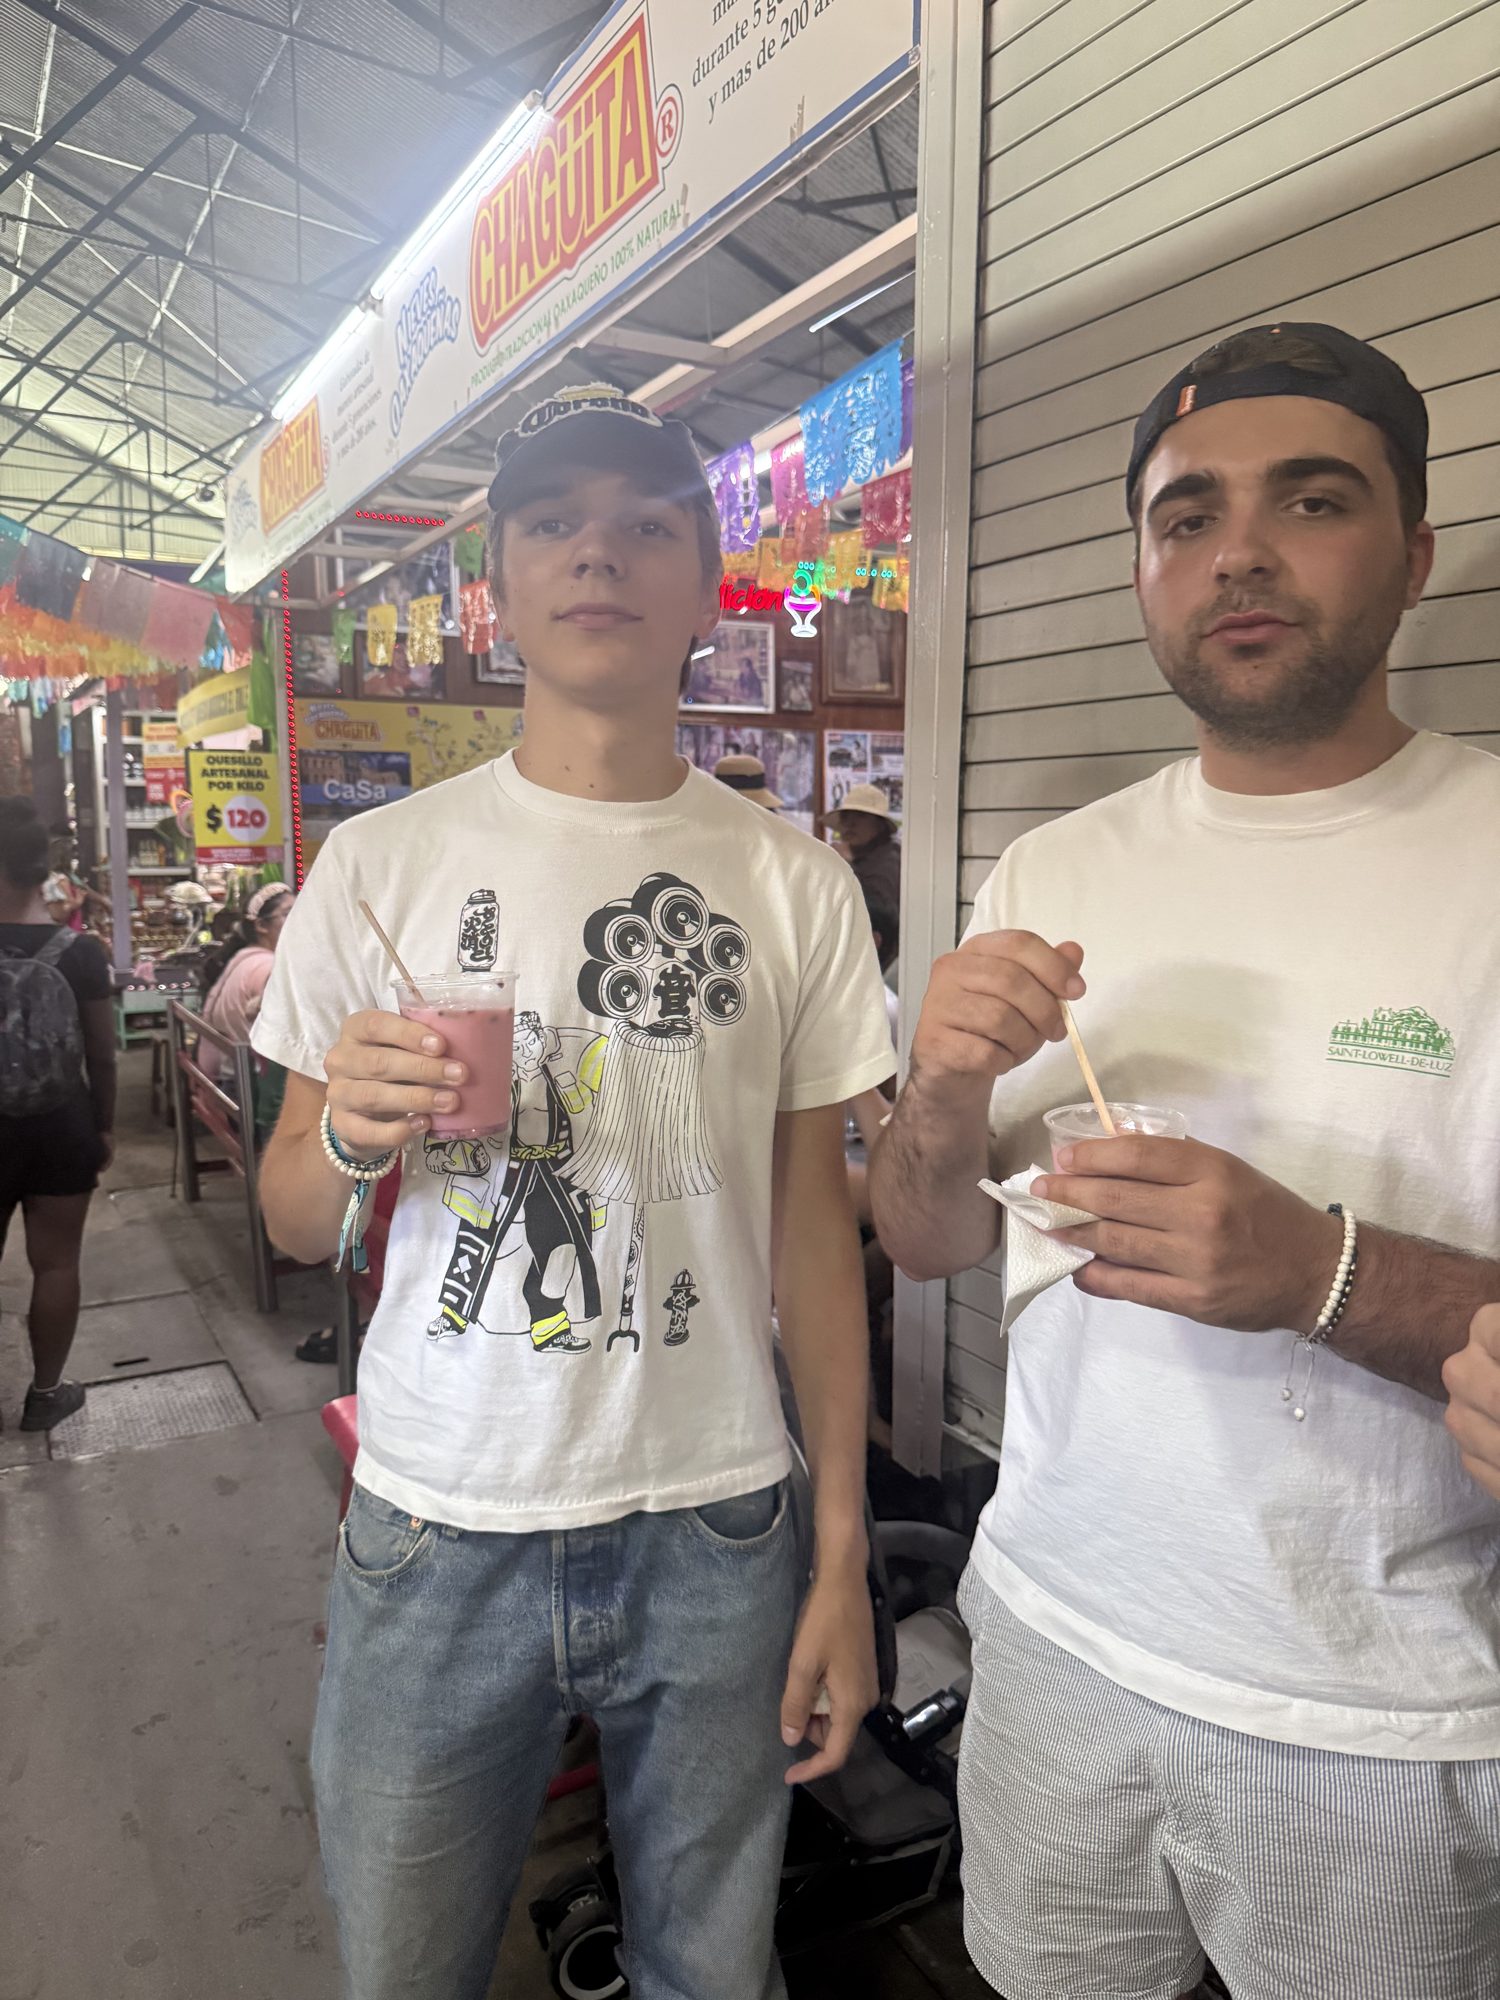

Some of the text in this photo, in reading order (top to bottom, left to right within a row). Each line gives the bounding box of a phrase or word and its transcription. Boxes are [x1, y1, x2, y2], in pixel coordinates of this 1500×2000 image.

[692, 18, 749, 87] durante
[753, 0, 762, 29] 5
[708, 90, 718, 124] y
[721, 67, 752, 104] mas
[757, 36, 776, 70] de
[780, 0, 809, 49] 200
[611, 237, 634, 275] 100%
[636, 199, 682, 252] NATURAL
[206, 755, 263, 766] QUESILLO
[201, 768, 270, 779] ARTESANAL
[208, 781, 265, 791] POR KILO
[323, 778, 386, 800] CaSa
[227, 808, 268, 829] 120
